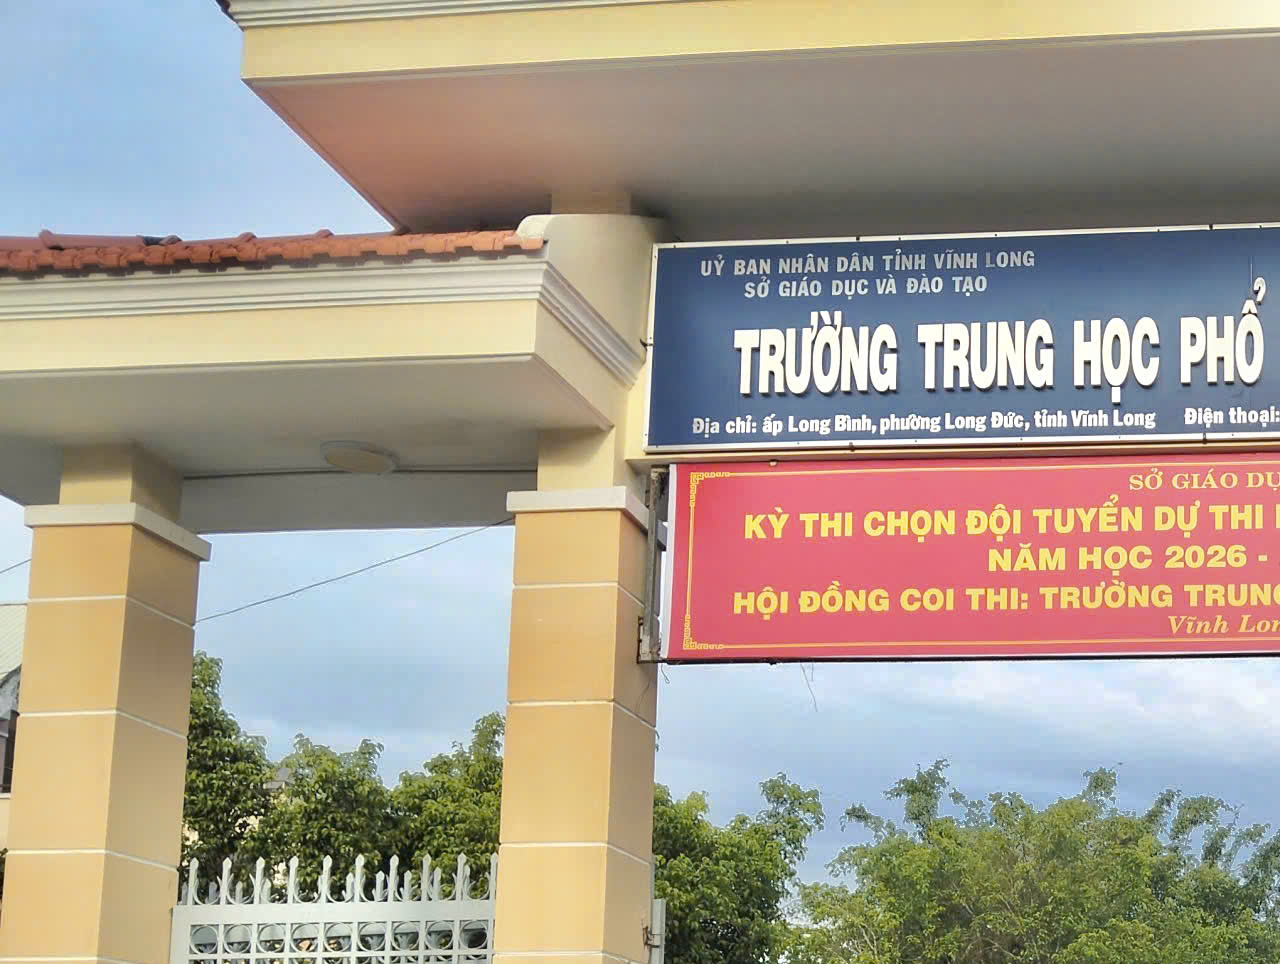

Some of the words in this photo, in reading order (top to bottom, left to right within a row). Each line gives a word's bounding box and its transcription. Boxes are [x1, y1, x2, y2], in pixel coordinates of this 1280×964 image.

[701, 254, 725, 277] UỶ
[734, 259, 771, 276] BAN
[778, 253, 829, 274] NHÂN
[836, 252, 874, 273] DÂN
[882, 248, 926, 271] TỈNH
[934, 252, 978, 269] VĨNH
[984, 250, 1035, 268] LONG
[744, 276, 771, 299] SỞ
[778, 276, 822, 297] GIÁO
[831, 278, 869, 300] DỤC
[875, 273, 897, 295] VÀ
[906, 273, 944, 294] ĐÀO
[951, 275, 987, 297] TẠO
[733, 310, 898, 394] TRƯỜNG
[917, 318, 1054, 389] TRUNG
[1073, 316, 1161, 403] HỌC
[1179, 276, 1267, 384] PHỔ
[692, 417, 720, 438] Địa
[725, 414, 757, 434] chỉ:
[761, 413, 784, 437] ấp
[787, 415, 832, 436] Long
[834, 413, 878, 435] Bình,
[879, 413, 942, 436] phường
[944, 412, 987, 433] Long
[990, 411, 1031, 432] Đức,
[1033, 408, 1068, 428] tỉnh
[1070, 409, 1109, 428] Vĩnh
[1112, 408, 1157, 430] Long
[1183, 407, 1225, 429] Điện
[1228, 405, 1280, 428] thoại:
[1128, 467, 1164, 491] SỞ
[1171, 467, 1239, 490] GIÁO
[744, 506, 790, 539] KỲ
[799, 511, 853, 538] THI
[863, 509, 956, 543] CHỌN
[965, 503, 1022, 543] ĐỘI
[1032, 493, 1143, 534] TUYỂN
[1154, 499, 1201, 539] DỰ
[1208, 503, 1264, 531] THI
[988, 542, 1066, 572] NĂM
[1078, 545, 1153, 577] HỌC
[1164, 544, 1248, 569] 2026
[1257, 554, 1268, 562] -
[733, 586, 789, 621] HỘI
[798, 580, 890, 613] ĐỒNG
[899, 587, 955, 612] COI
[965, 587, 1029, 611] THI:
[1039, 579, 1173, 610] TRƯỜNG
[1168, 614, 1229, 634] Vĩnh
